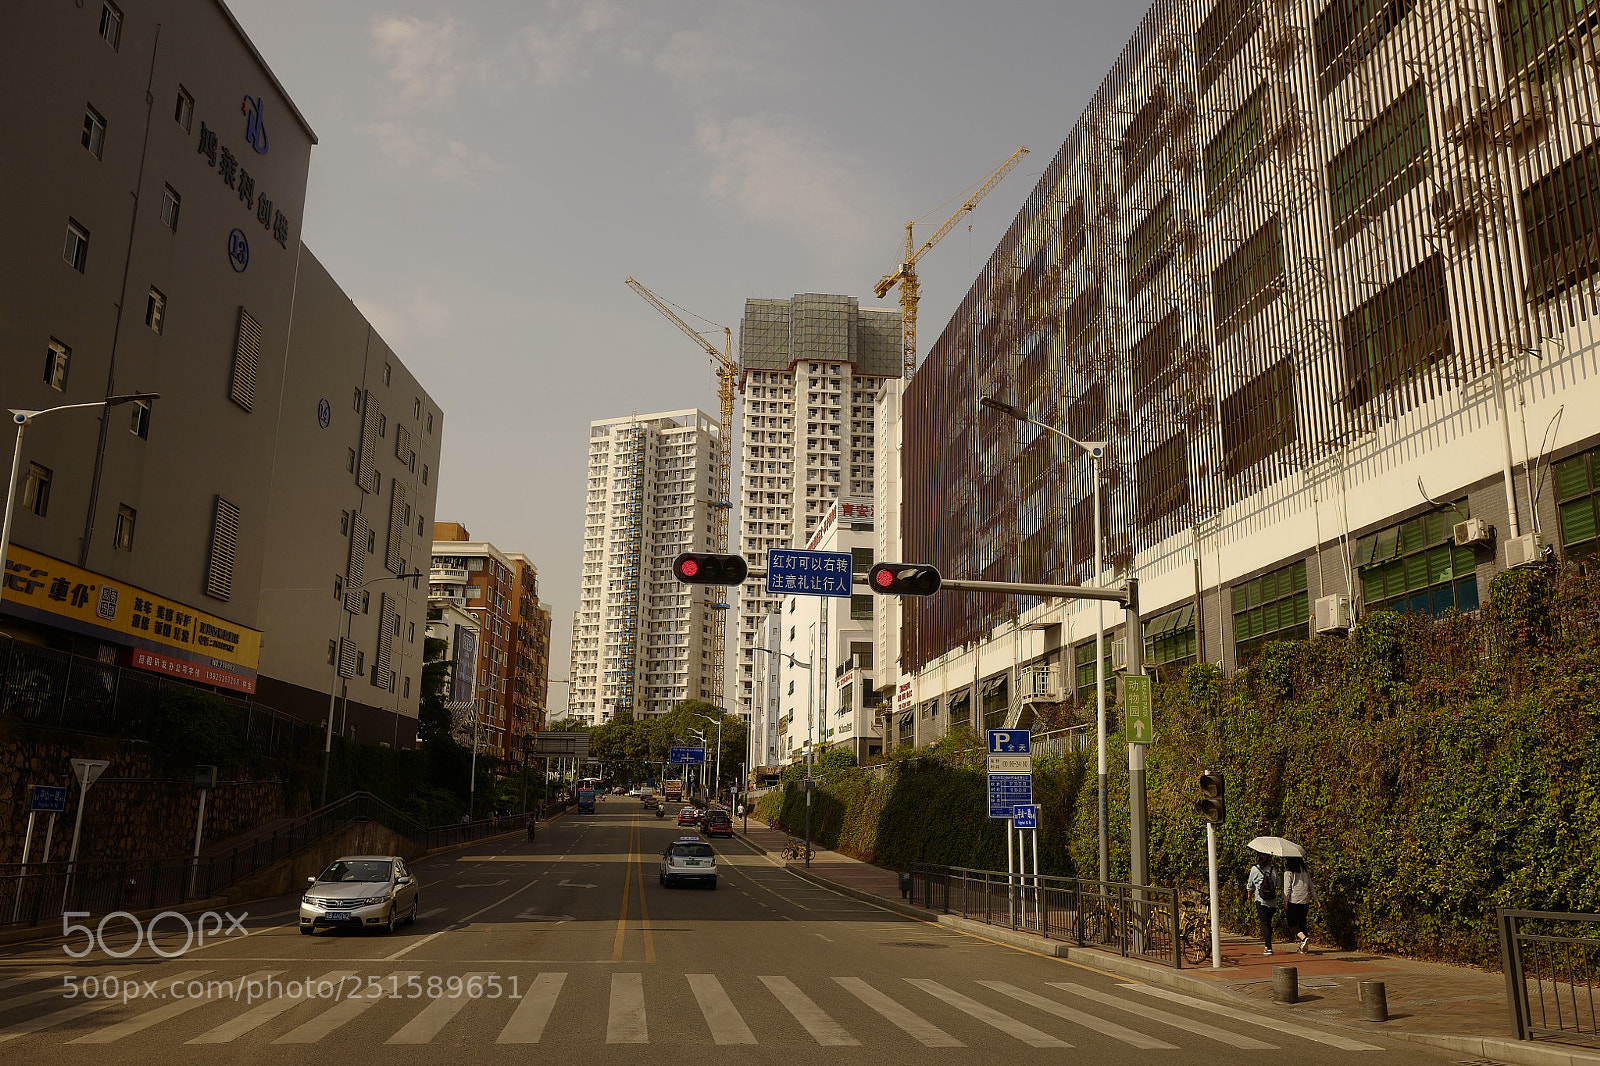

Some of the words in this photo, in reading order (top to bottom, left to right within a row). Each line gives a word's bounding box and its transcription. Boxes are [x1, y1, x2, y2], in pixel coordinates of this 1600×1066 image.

[230, 233, 247, 265] 13
[772, 554, 849, 573] 红灯可以右转
[771, 573, 848, 592] 注意礼让行人
[1128, 679, 1140, 717] 动物园
[993, 732, 1011, 752] P
[1007, 743, 1027, 752] 全天
